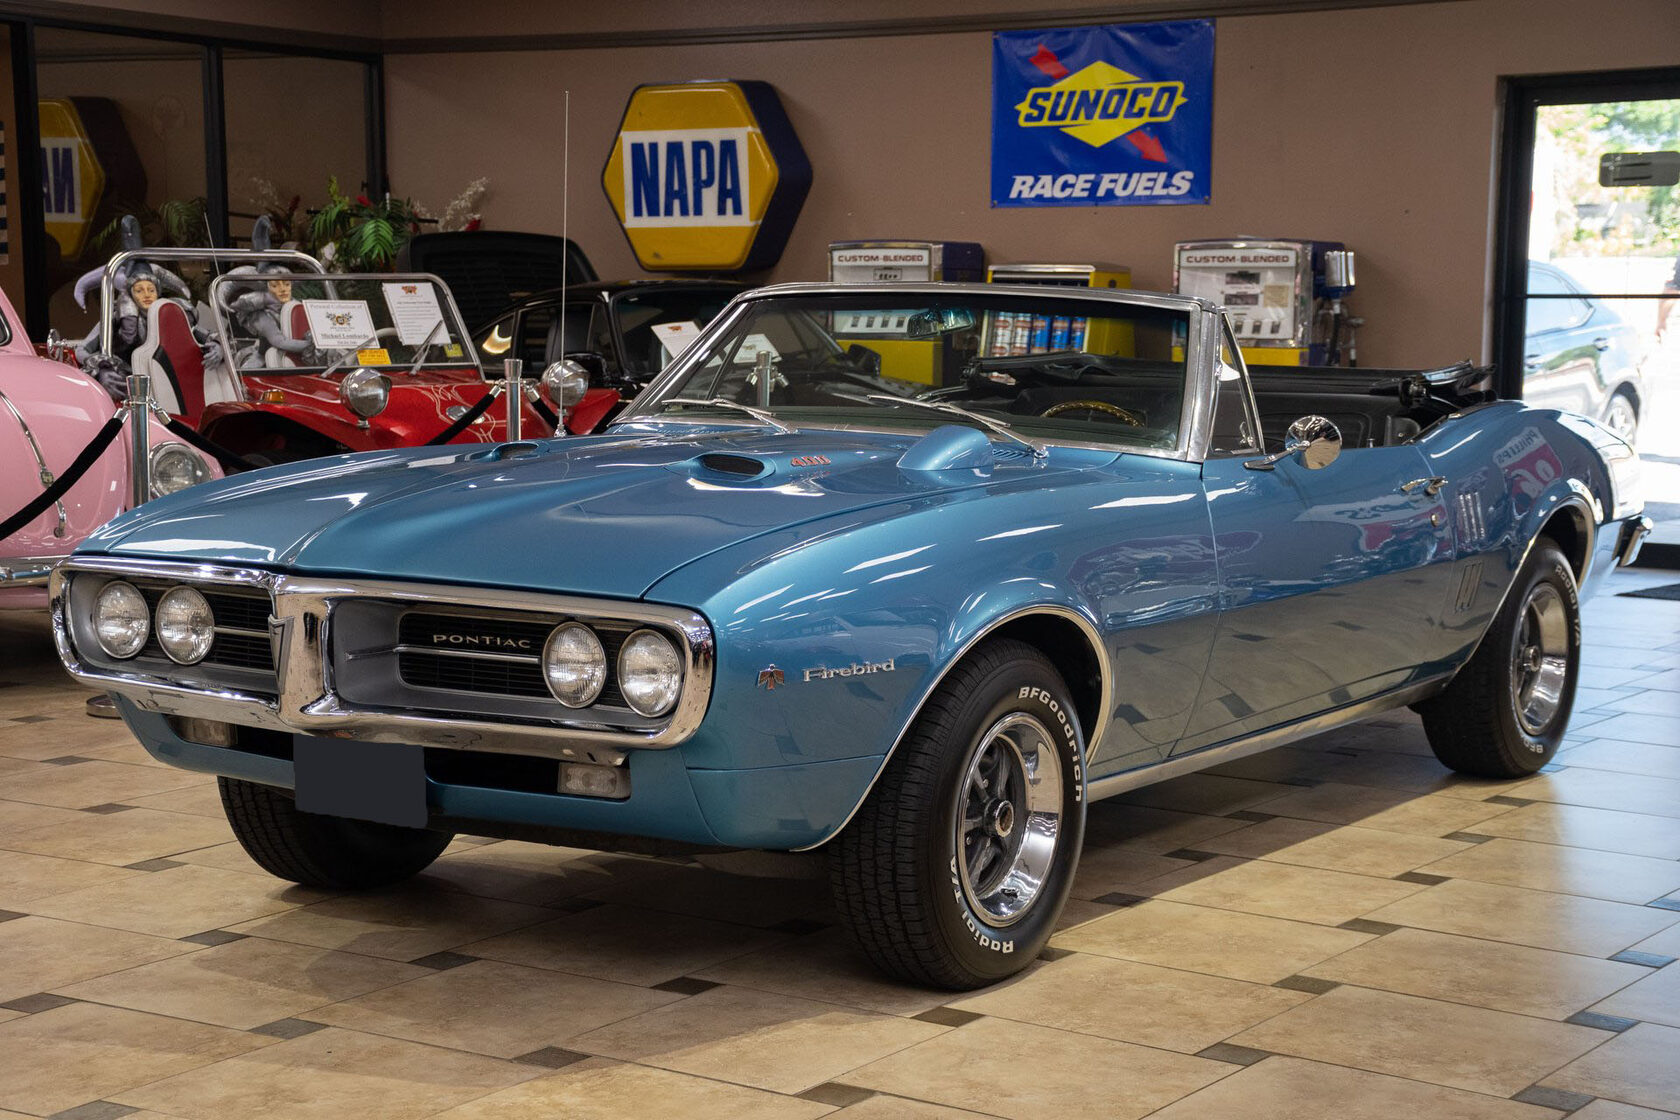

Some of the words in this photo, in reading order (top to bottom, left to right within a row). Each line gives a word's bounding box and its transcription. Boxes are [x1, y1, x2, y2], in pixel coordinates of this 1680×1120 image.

[1023, 85, 1180, 123] SUNOCO
[631, 139, 743, 217] NAPA
[1009, 173, 1097, 199] RACE
[1096, 170, 1194, 198] FUELS
[433, 634, 531, 649] PONTIAC
[802, 658, 896, 682] Firebird
[1017, 686, 1083, 802] BFGoodrich
[949, 855, 961, 904] T/A
[961, 910, 1014, 954] Radial
